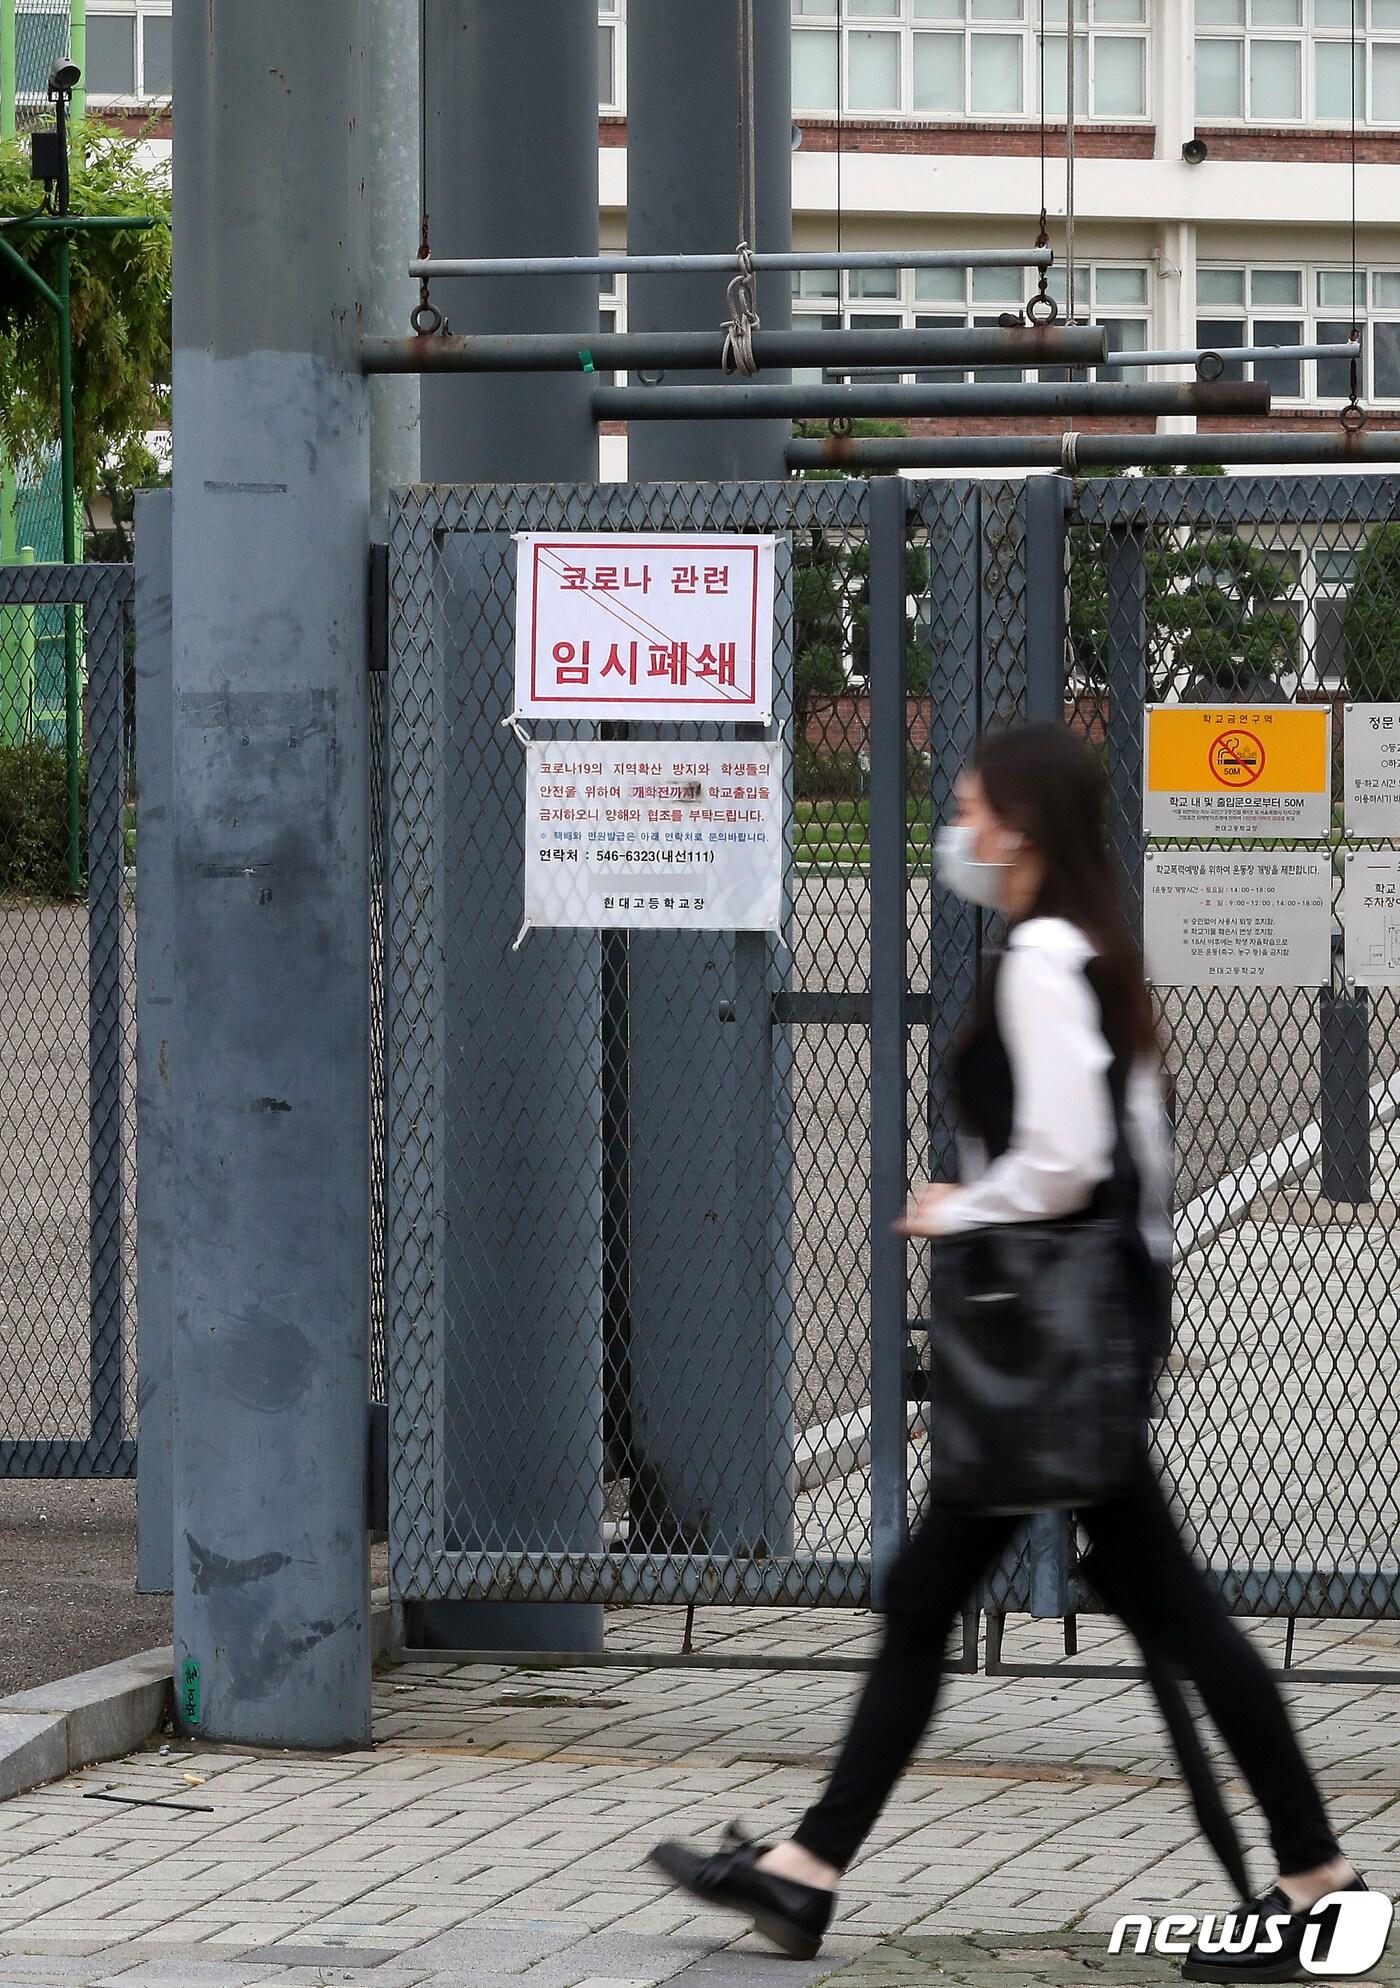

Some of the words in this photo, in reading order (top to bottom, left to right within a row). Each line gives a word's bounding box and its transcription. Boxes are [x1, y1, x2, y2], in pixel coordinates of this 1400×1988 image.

[560, 565, 652, 594] 코로나
[671, 565, 729, 594] 관련
[552, 641, 736, 686] 임시폐쇄
[1369, 716, 1393, 730] 정문
[540, 763, 602, 775] 코로나19의
[613, 763, 662, 776] 지역확산
[672, 763, 710, 776] 방지와
[720, 763, 770, 776] 학생들의
[1224, 767, 1241, 775] 50M
[1381, 779, 1395, 788] 시간
[540, 786, 576, 798] 안전을
[584, 786, 621, 799] 위하여
[632, 786, 694, 799] 개학전까지
[708, 786, 770, 799] 학교출입을
[1354, 794, 1391, 803] 이용하시기
[1170, 797, 1188, 807] 학교
[1191, 797, 1200, 807] 내
[1204, 797, 1213, 807] 및
[1217, 797, 1281, 808] 출입문으로부터
[1284, 798, 1304, 807] 50M
[539, 809, 599, 821] 금지하오니
[605, 809, 641, 822] 양해와
[647, 809, 683, 822] 협조를
[689, 809, 765, 822] 부탁드립니다.
[554, 832, 582, 842] 택배와
[587, 832, 635, 842] 민원발급은
[641, 832, 660, 842] 아래
[664, 832, 703, 842] 연락처로
[708, 832, 769, 843] 문의바랍니다.
[539, 849, 578, 863] 연락처
[596, 849, 715, 863] 546-6323(내선111)
[1208, 865, 1230, 876] 위하여
[1233, 865, 1255, 876] 운동장
[1375, 883, 1396, 894] 학교
[603, 897, 705, 910] 현대고등학교장
